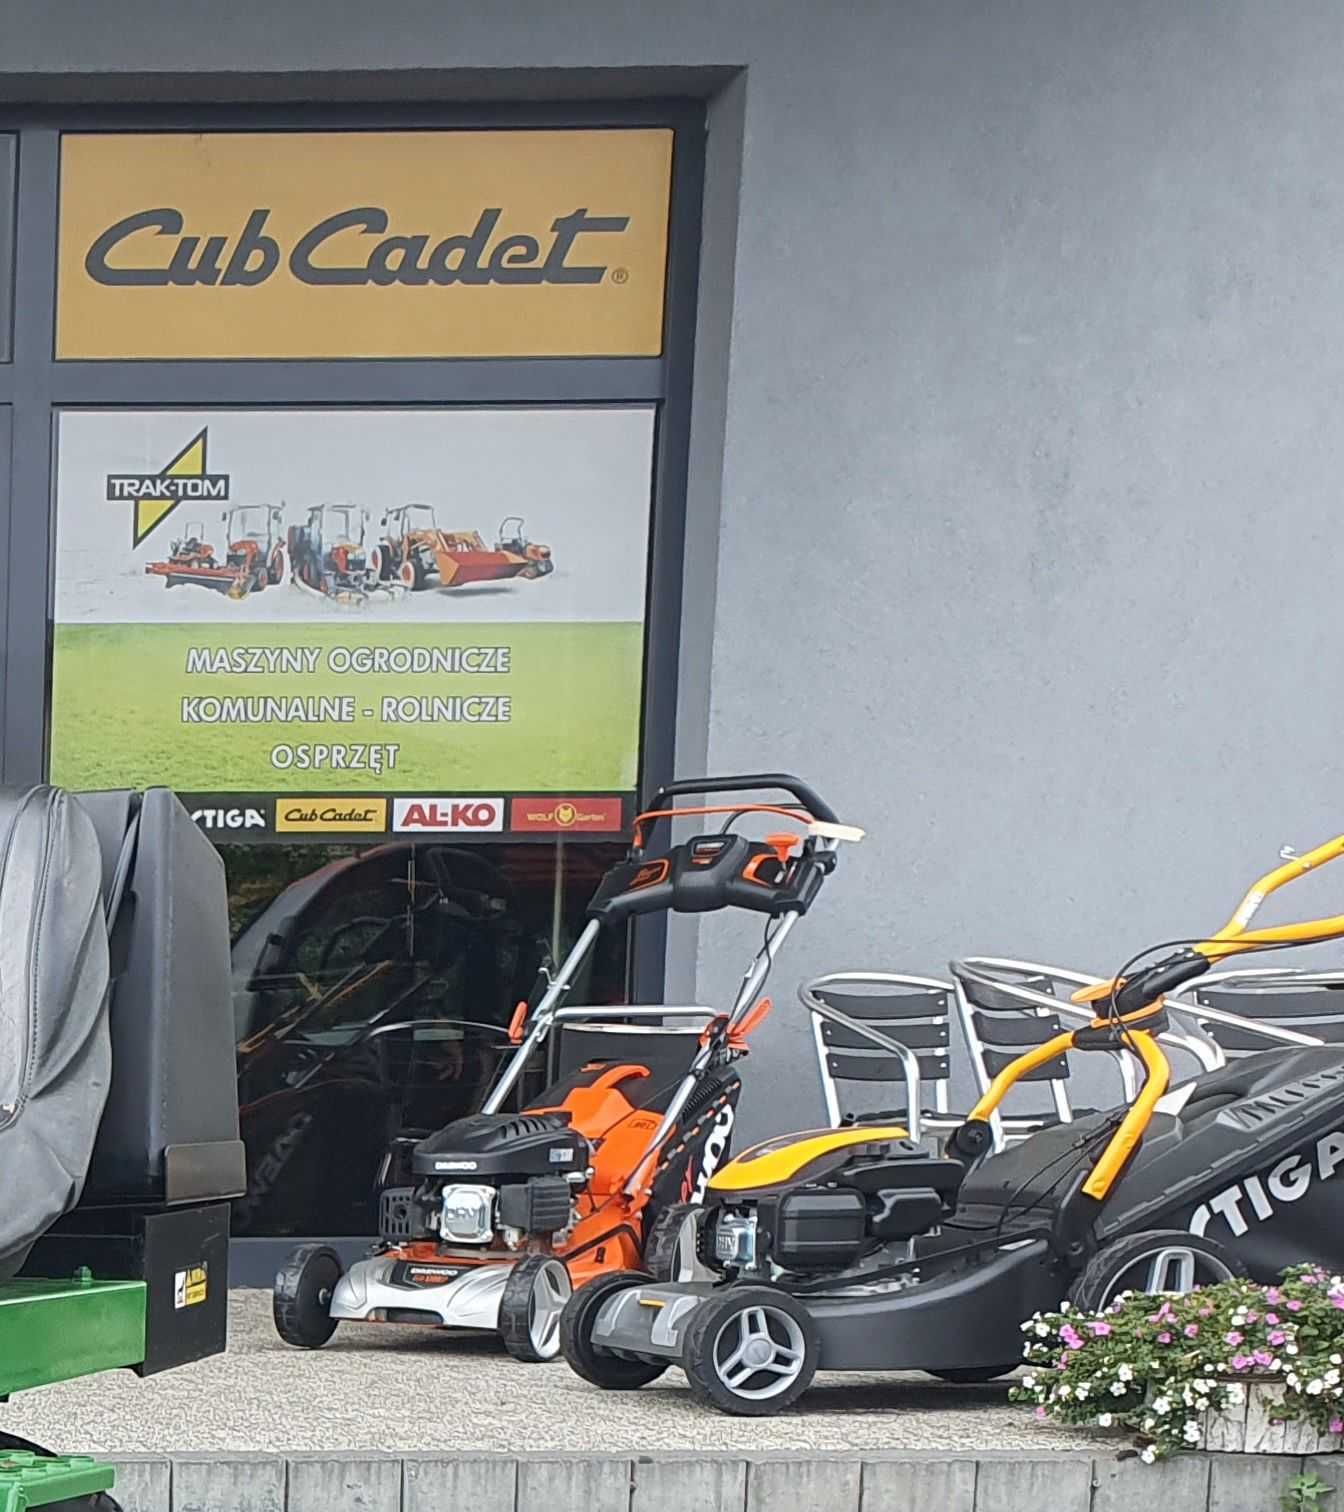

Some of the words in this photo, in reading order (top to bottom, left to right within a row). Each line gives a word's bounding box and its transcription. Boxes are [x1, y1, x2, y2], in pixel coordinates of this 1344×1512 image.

[84, 207, 280, 286] Cub
[289, 207, 630, 286] Cadet
[110, 478, 225, 498] TRAK-TOM
[186, 647, 322, 674] MASZYNY
[328, 646, 511, 674] OGRODNICZE
[181, 697, 355, 723] KOMUNALNE
[381, 696, 511, 723] ROLNICZE
[271, 744, 399, 772] OSPRZĘT
[284, 808, 316, 822] Cub
[319, 808, 377, 822] Cadet
[401, 803, 496, 827] AL-KO
